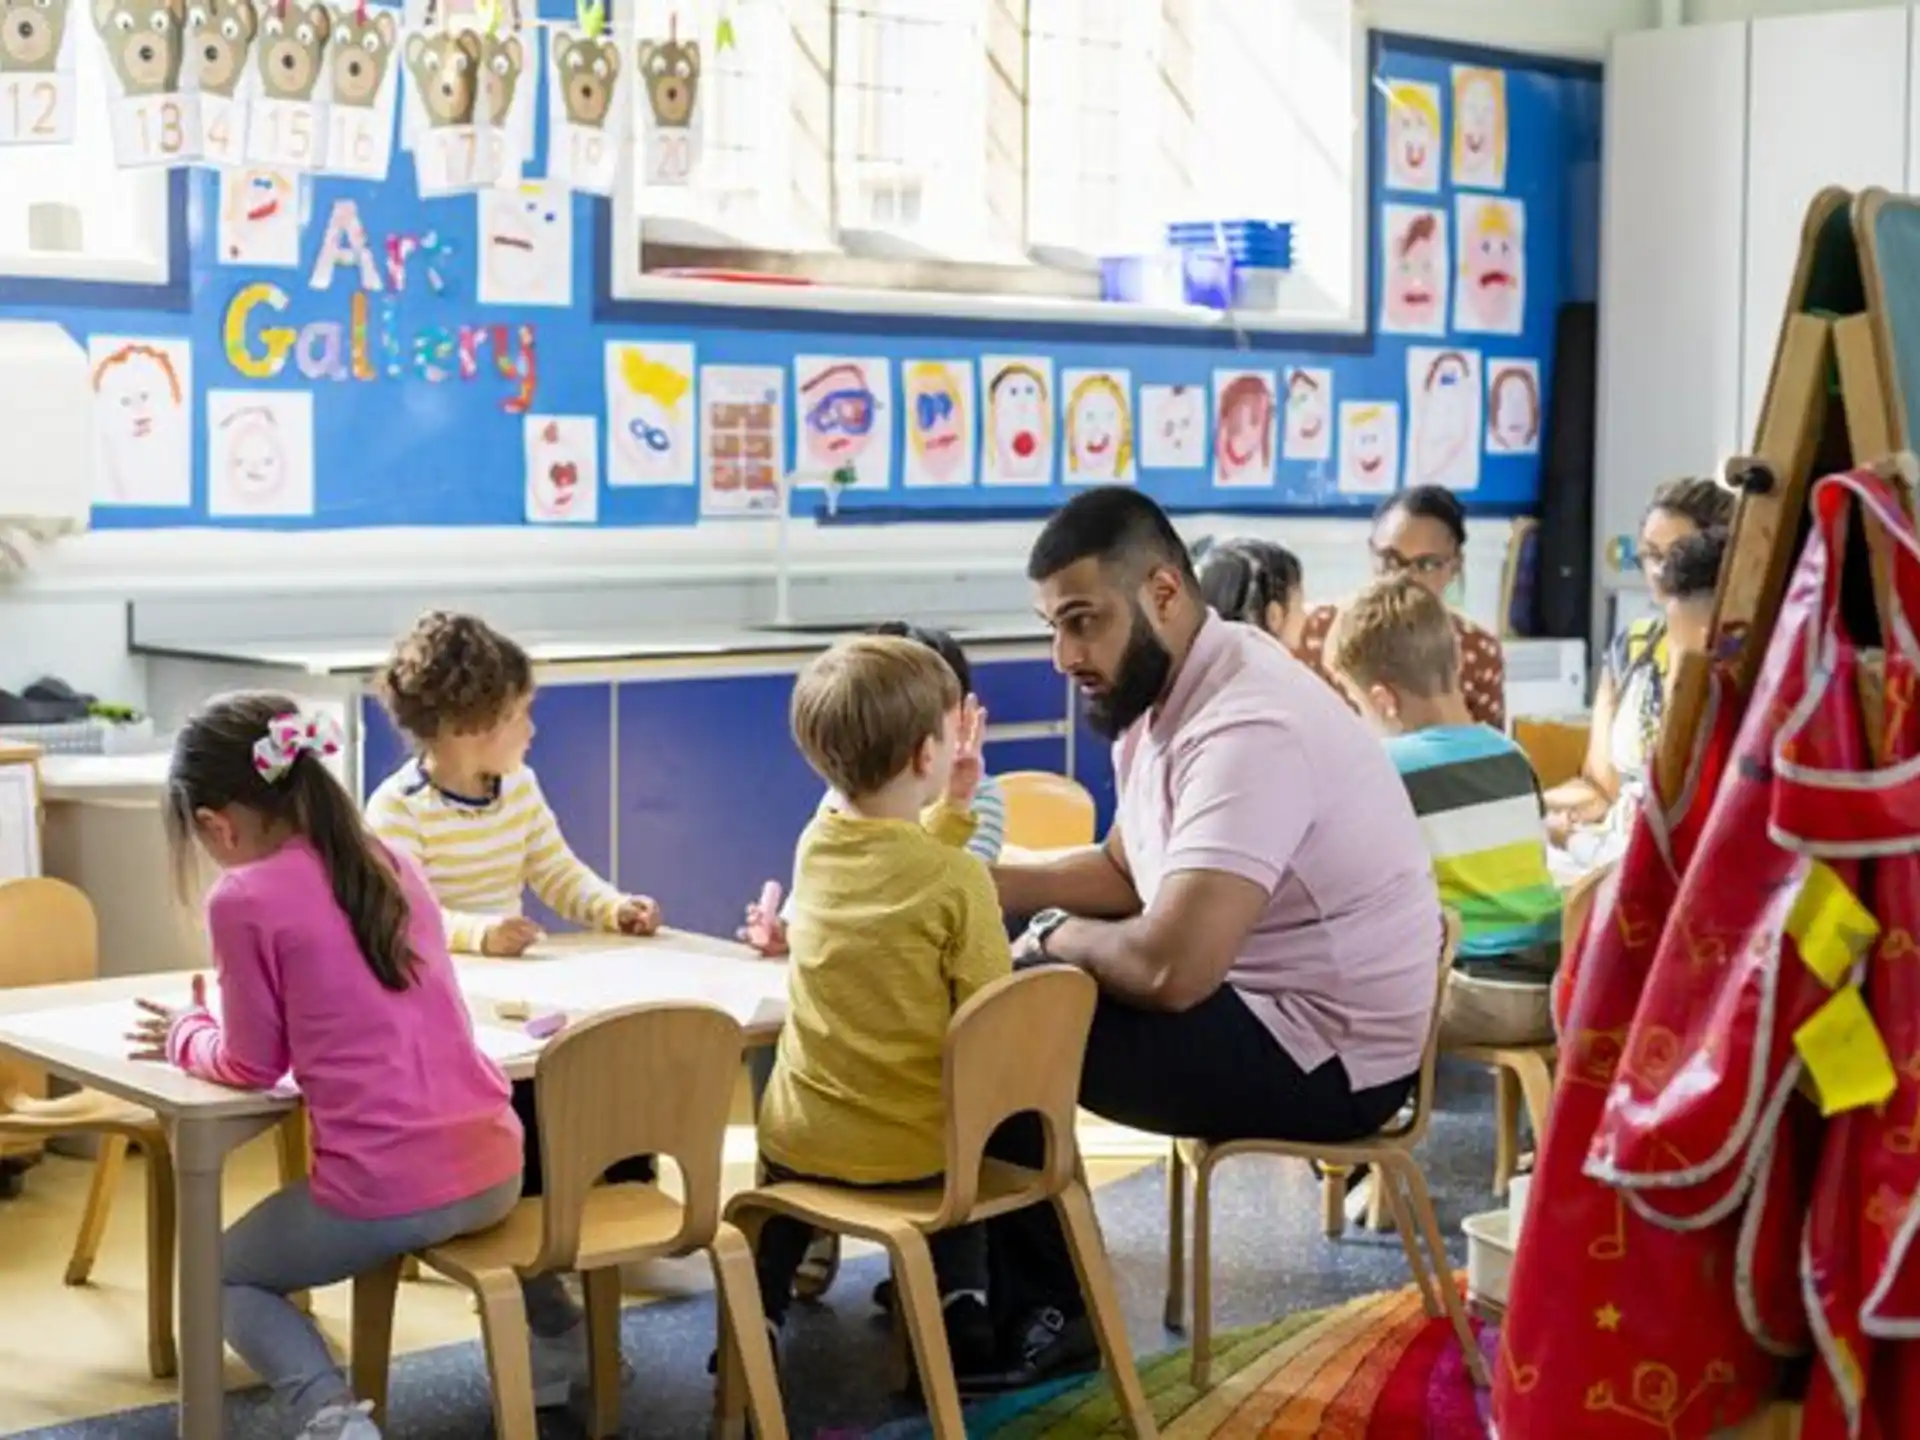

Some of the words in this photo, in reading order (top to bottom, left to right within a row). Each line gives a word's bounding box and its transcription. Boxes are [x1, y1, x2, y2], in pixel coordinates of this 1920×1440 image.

[7, 81, 58, 136] 12
[136, 100, 184, 154] 13
[205, 109, 232, 155] 4
[268, 108, 311, 158] 15
[337, 114, 374, 163] 16
[656, 135, 690, 177] 20
[308, 199, 451, 295] Art
[224, 281, 537, 414] Gallery
